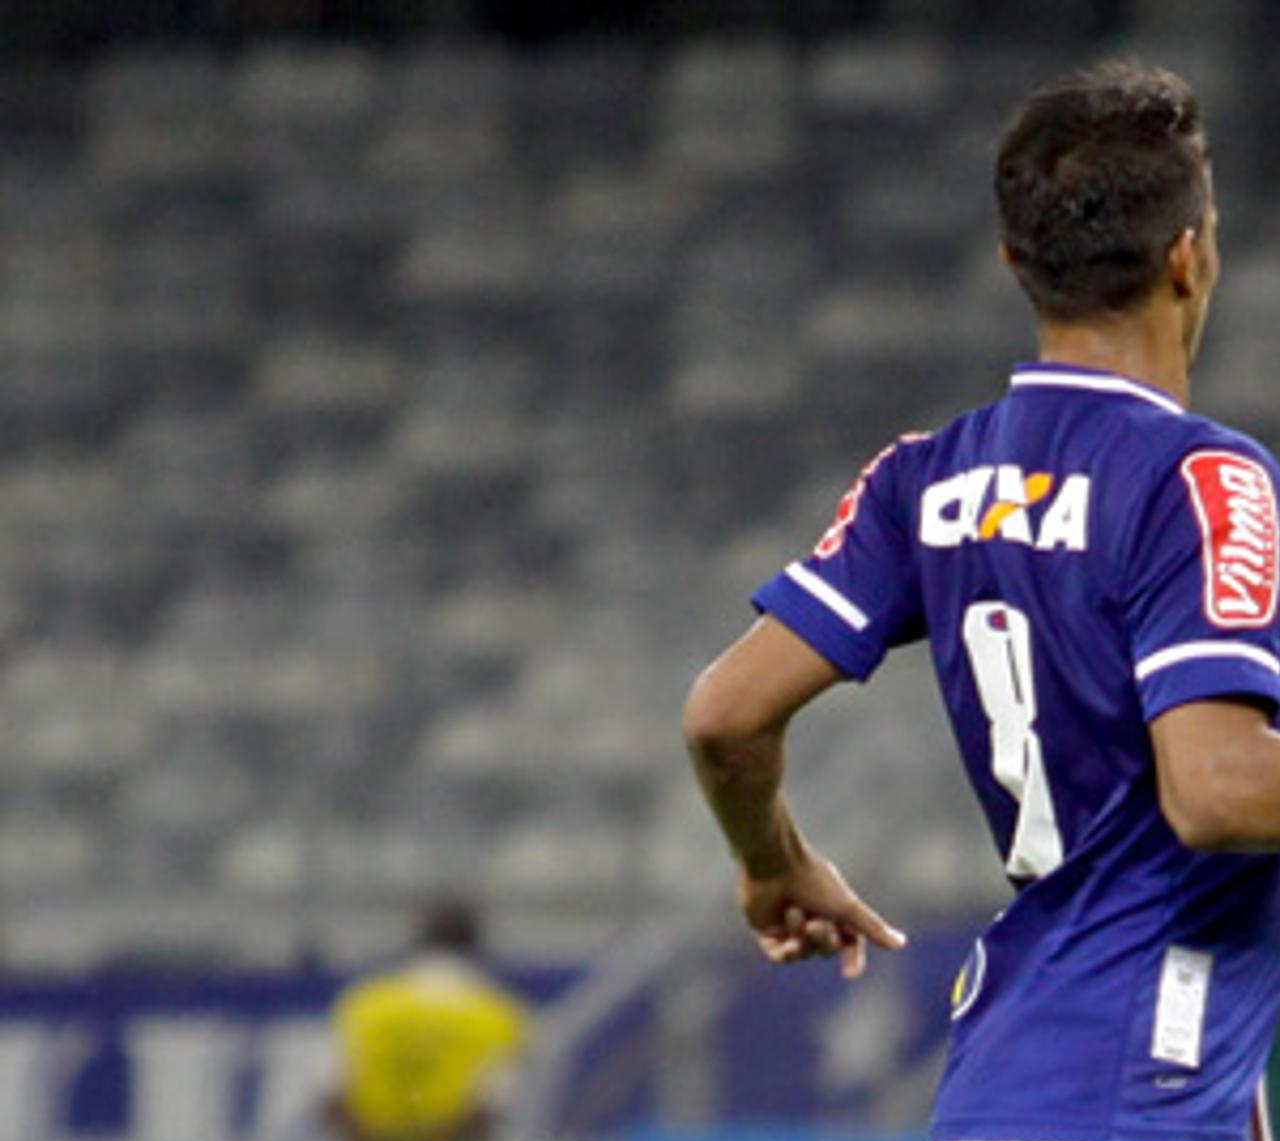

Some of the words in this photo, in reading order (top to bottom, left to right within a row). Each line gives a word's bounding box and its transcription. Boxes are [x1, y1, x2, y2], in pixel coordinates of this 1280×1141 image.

[919, 464, 1091, 551] CAXA
[1217, 464, 1266, 615] Vilma
[962, 600, 1065, 878] 8
